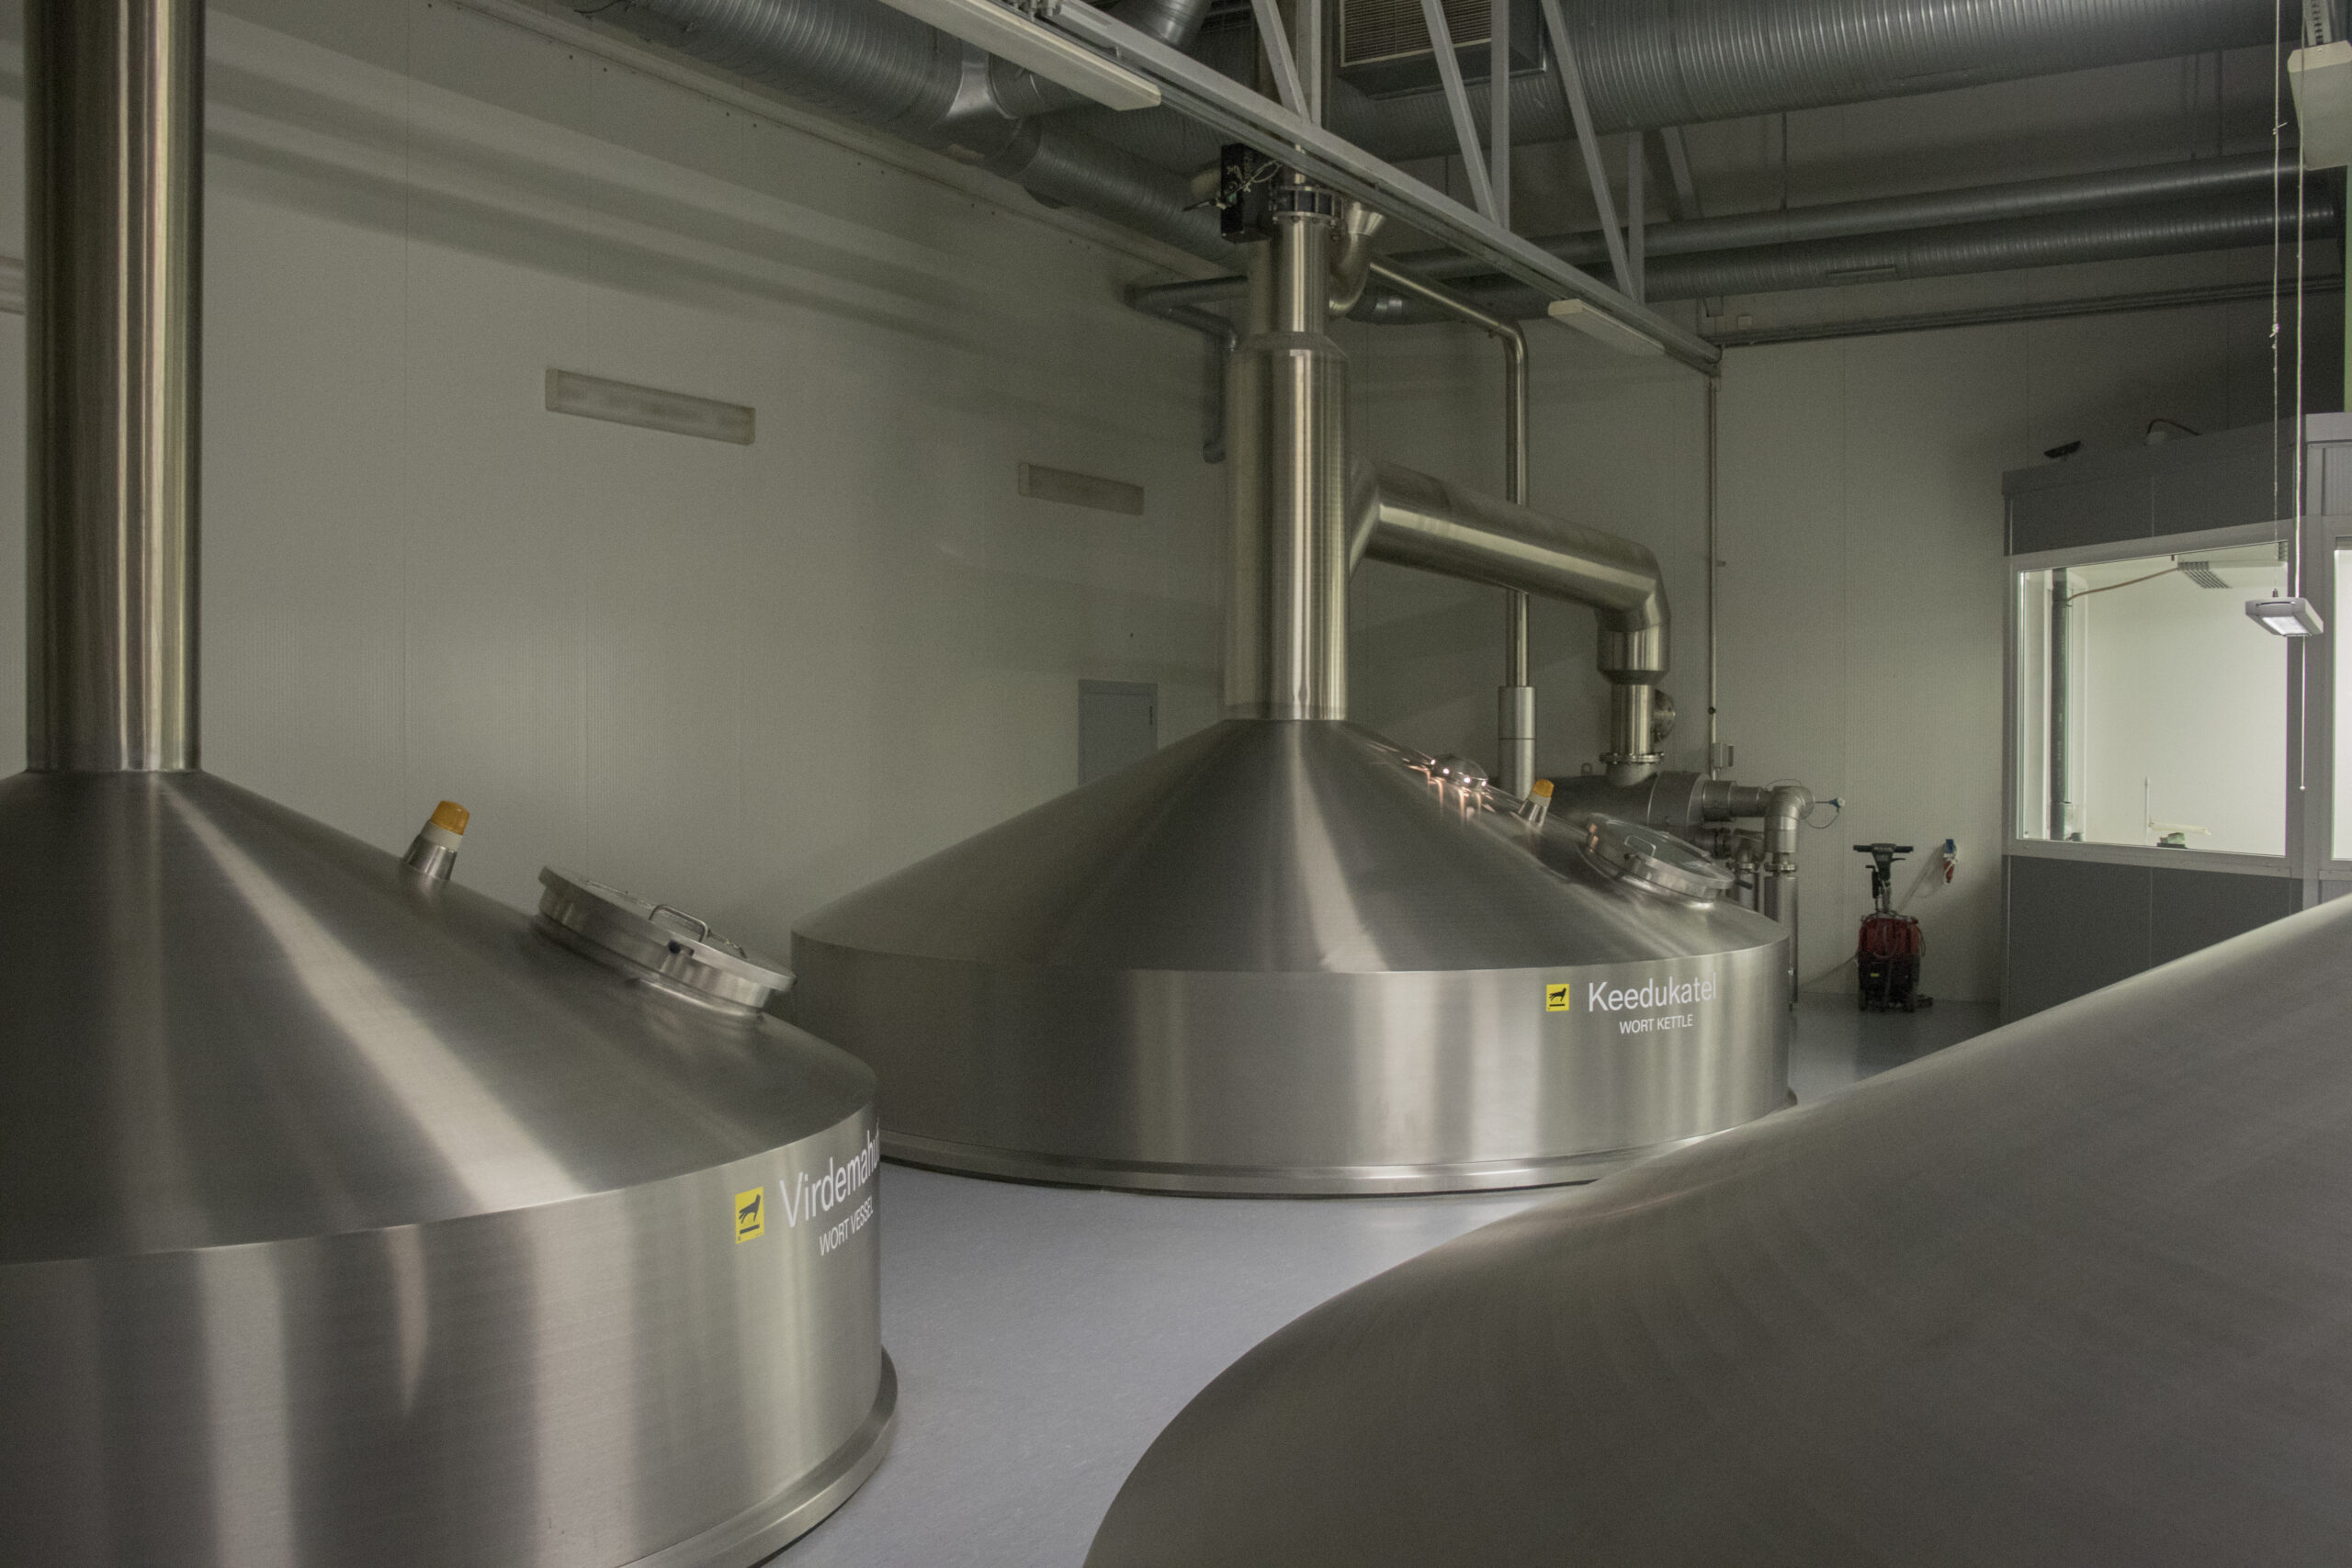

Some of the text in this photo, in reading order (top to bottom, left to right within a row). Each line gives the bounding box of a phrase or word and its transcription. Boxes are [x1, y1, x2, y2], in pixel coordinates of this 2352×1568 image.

[1589, 971, 1716, 1012] Keedukatel
[1619, 1013, 1693, 1034] WORT KETTLE
[819, 1195, 874, 1257] WORT VESSEL
